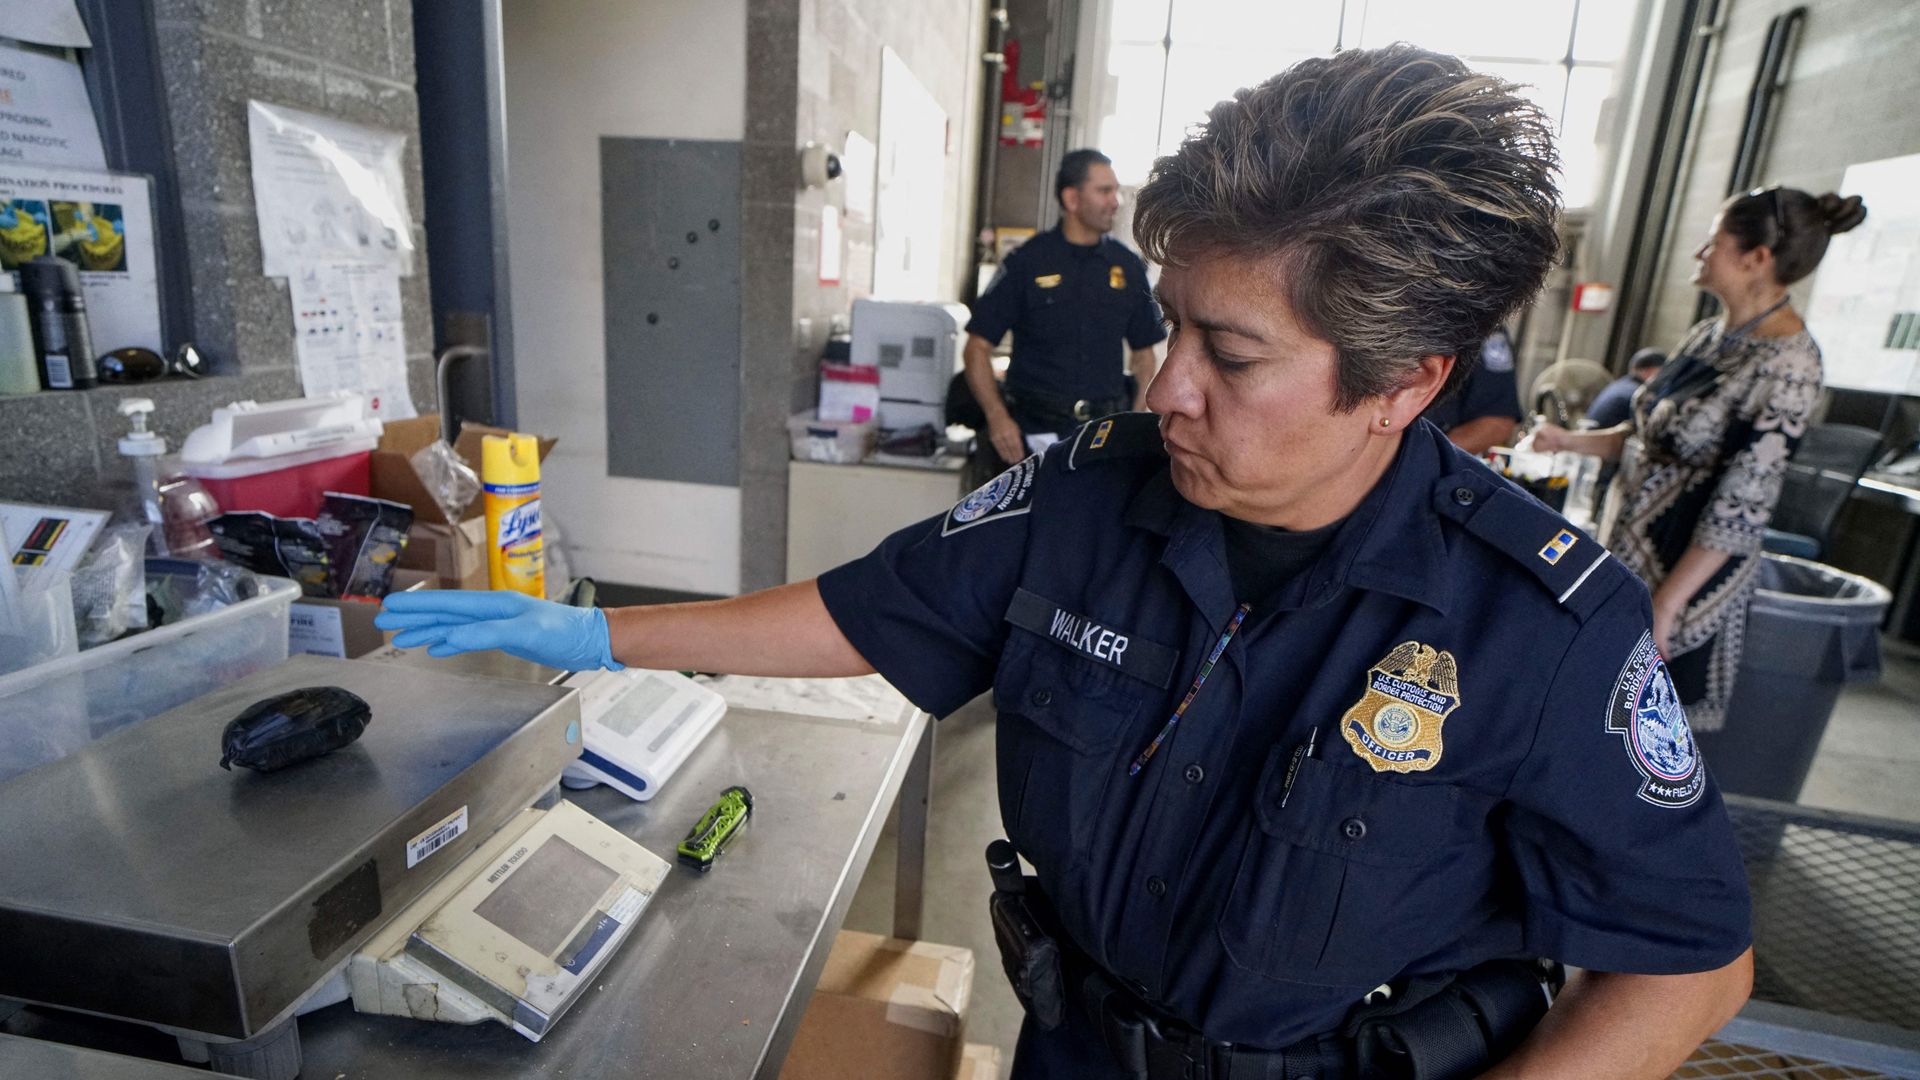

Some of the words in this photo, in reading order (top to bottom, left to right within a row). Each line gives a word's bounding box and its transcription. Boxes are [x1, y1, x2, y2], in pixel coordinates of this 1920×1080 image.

[1049, 608, 1129, 666] WALKER
[1373, 681, 1400, 698] BORDER
[1400, 691, 1445, 714] PROTECTION
[1377, 673, 1391, 685] U.S.
[1393, 679, 1429, 699] CUSTOMS
[1429, 693, 1447, 705] AND
[1624, 667, 1646, 710] BORDER
[1361, 733, 1415, 761] OFFICER
[1672, 784, 1693, 798] FIELD
